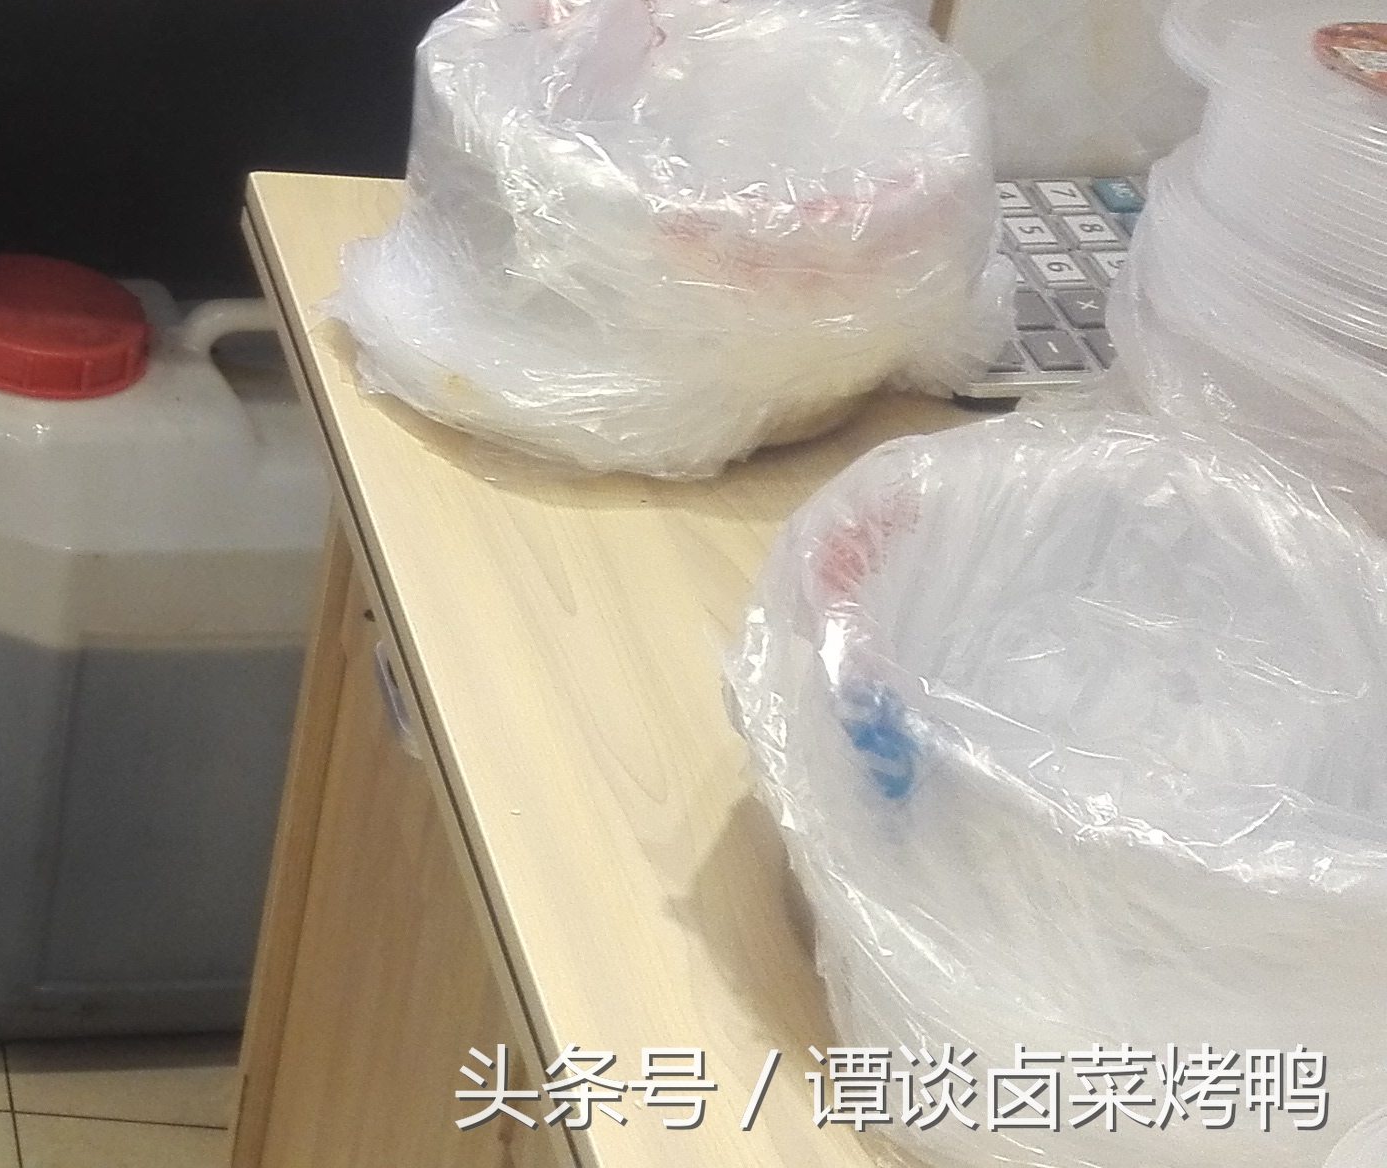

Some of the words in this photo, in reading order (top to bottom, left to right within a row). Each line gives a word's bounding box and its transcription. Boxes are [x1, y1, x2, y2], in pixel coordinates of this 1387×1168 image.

[1052, 188, 1078, 199] 7
[1079, 223, 1104, 233] 8
[1018, 225, 1045, 234] 5
